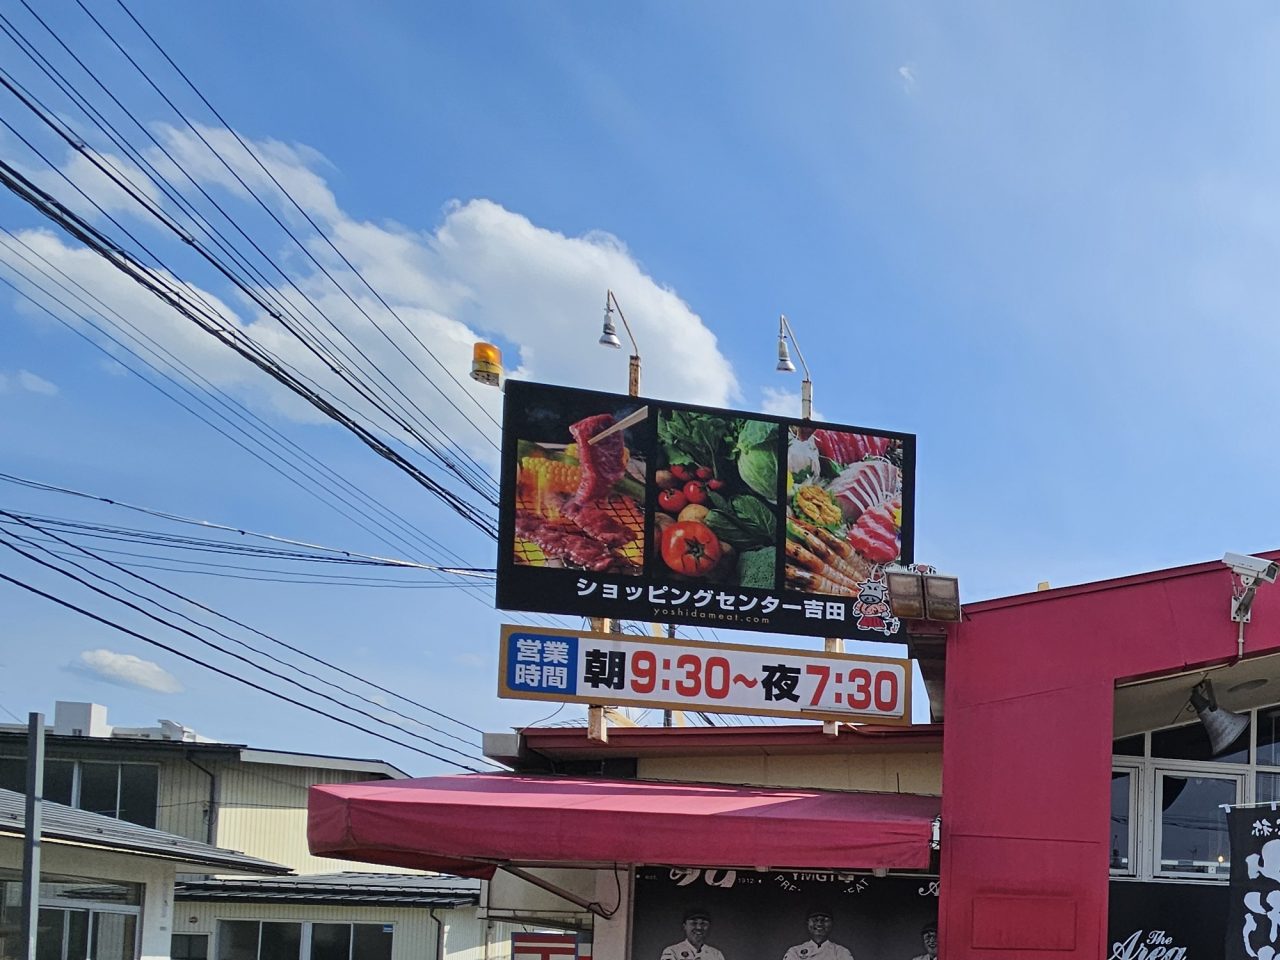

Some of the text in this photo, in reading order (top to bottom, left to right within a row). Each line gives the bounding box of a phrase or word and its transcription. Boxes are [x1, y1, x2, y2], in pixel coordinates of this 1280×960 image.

[576, 577, 845, 621] ショッピングセンター吉田
[653, 607, 770, 624] yoshidameat.com
[516, 638, 569, 665] 営業
[514, 663, 568, 690] 時間
[1146, 930, 1173, 946] The
